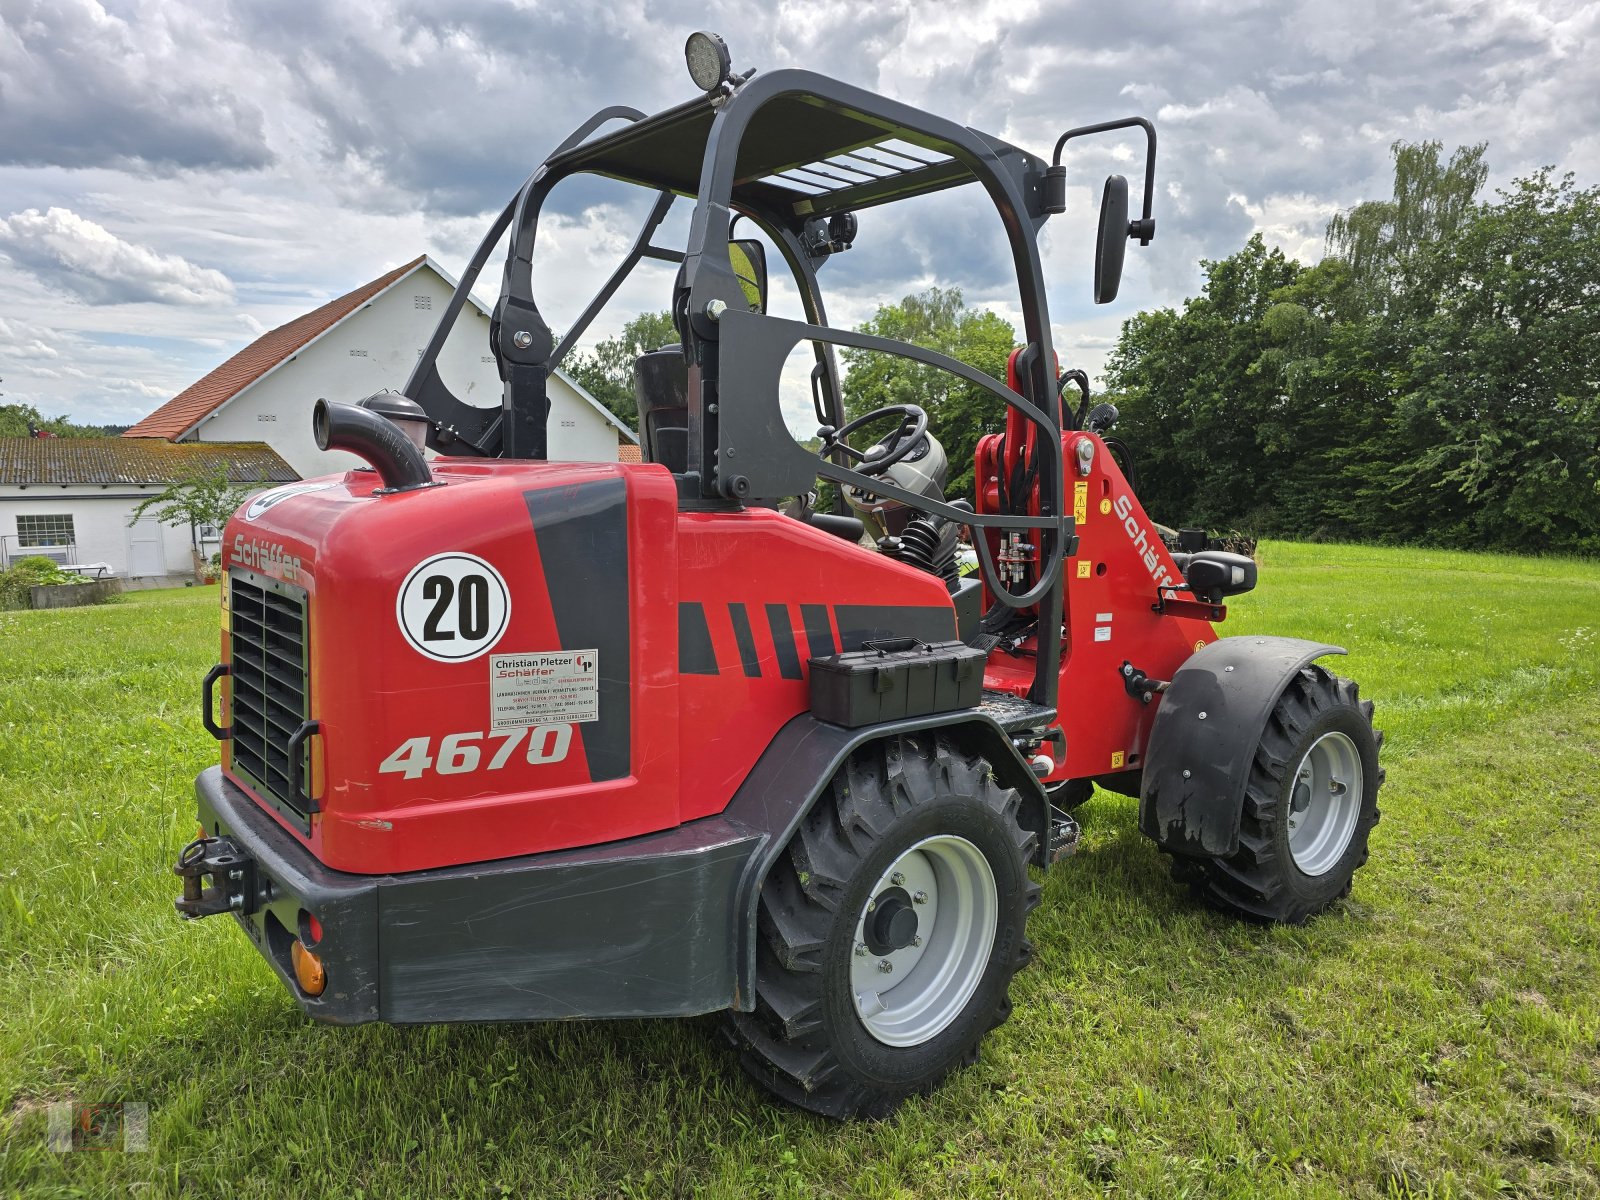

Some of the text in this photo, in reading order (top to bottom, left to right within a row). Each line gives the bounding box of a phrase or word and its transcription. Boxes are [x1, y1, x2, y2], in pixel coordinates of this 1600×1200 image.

[230, 534, 301, 581] Schäffer
[422, 574, 490, 642] 20
[495, 656, 573, 669] Christian Pletzer
[496, 668, 555, 678] Schäffer
[378, 723, 573, 781] 4670
